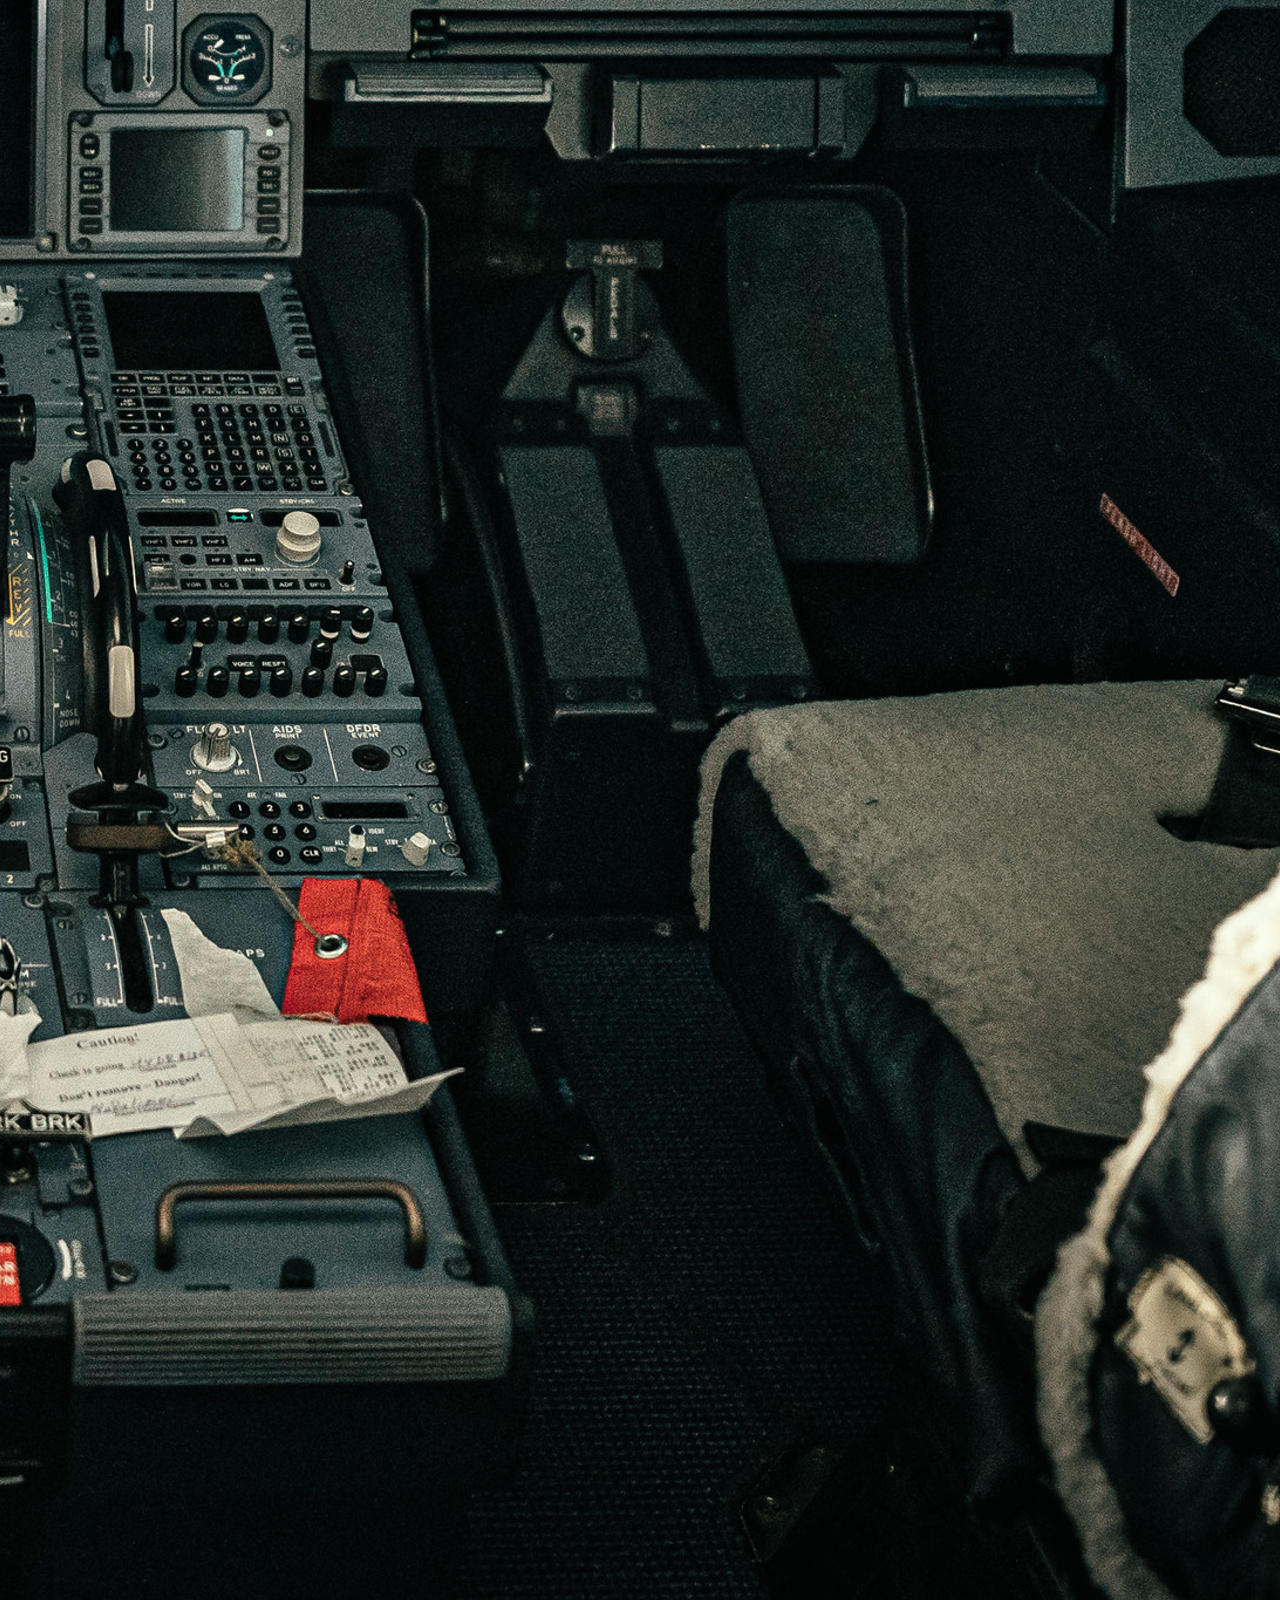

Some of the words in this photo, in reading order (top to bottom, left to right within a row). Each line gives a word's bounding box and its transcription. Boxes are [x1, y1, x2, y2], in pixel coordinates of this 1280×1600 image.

[232, 725, 246, 734] LT
[273, 725, 302, 733] AIDS
[347, 725, 381, 733] DFDR
[77, 1032, 139, 1049] Caution!
[96, 1084, 141, 1097] remove
[155, 1073, 202, 1087] Danger!
[31, 1114, 83, 1129] BRK
